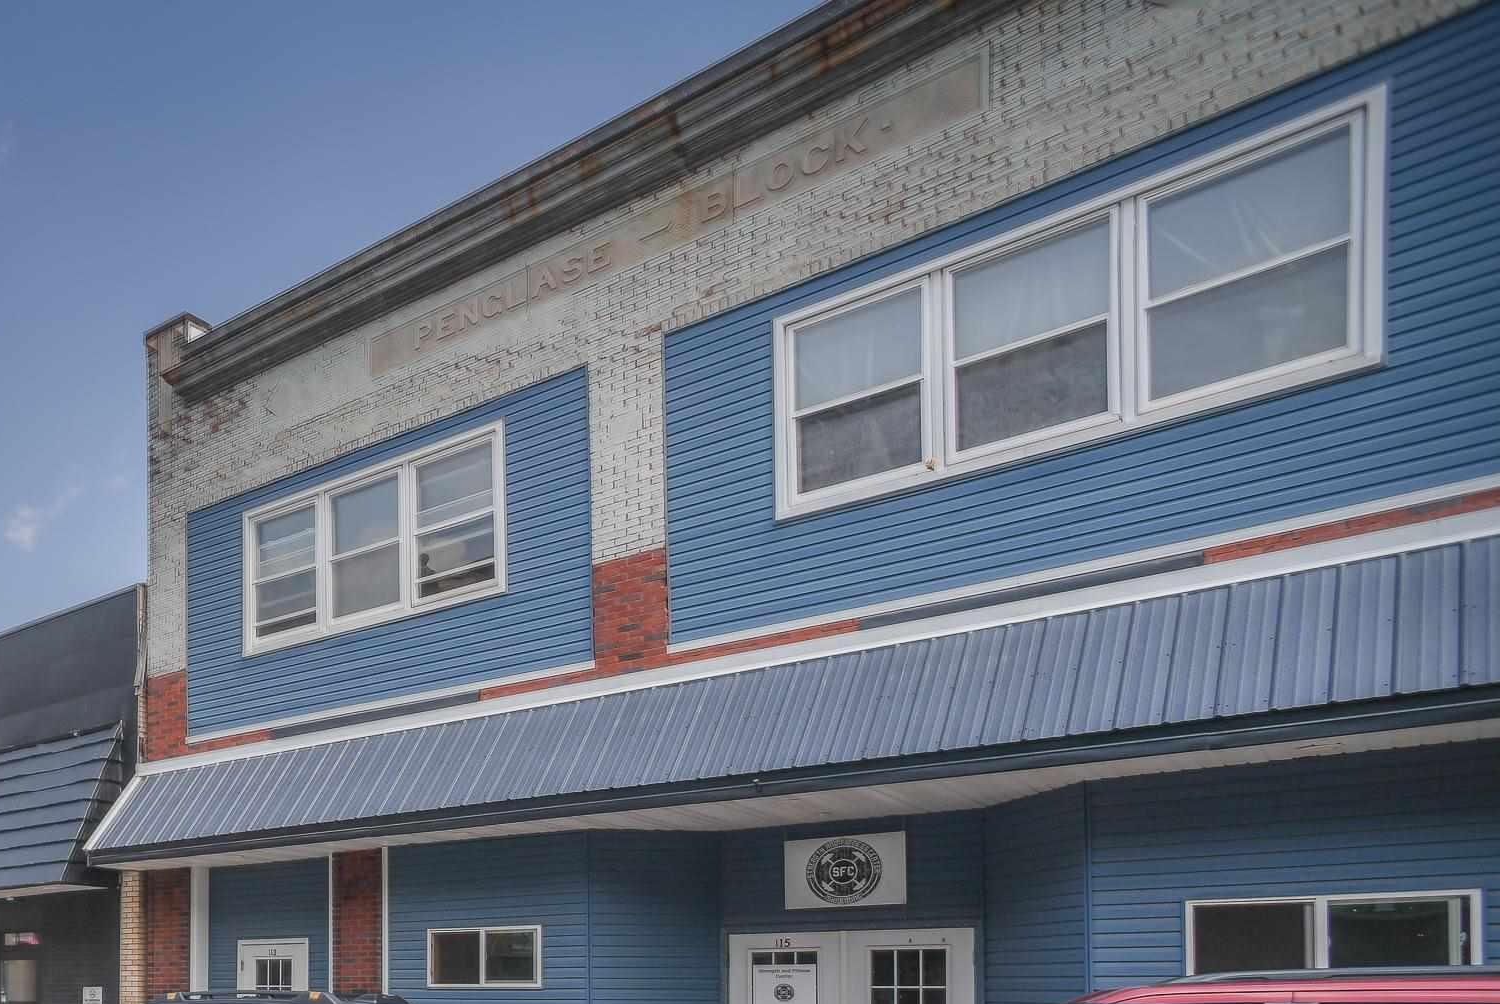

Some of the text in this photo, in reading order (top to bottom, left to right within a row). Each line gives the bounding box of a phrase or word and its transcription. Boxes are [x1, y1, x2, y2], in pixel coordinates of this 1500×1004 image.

[414, 114, 869, 352] PENCLASE BLOCK
[832, 865, 855, 878] SFC
[774, 938, 791, 948] 115
